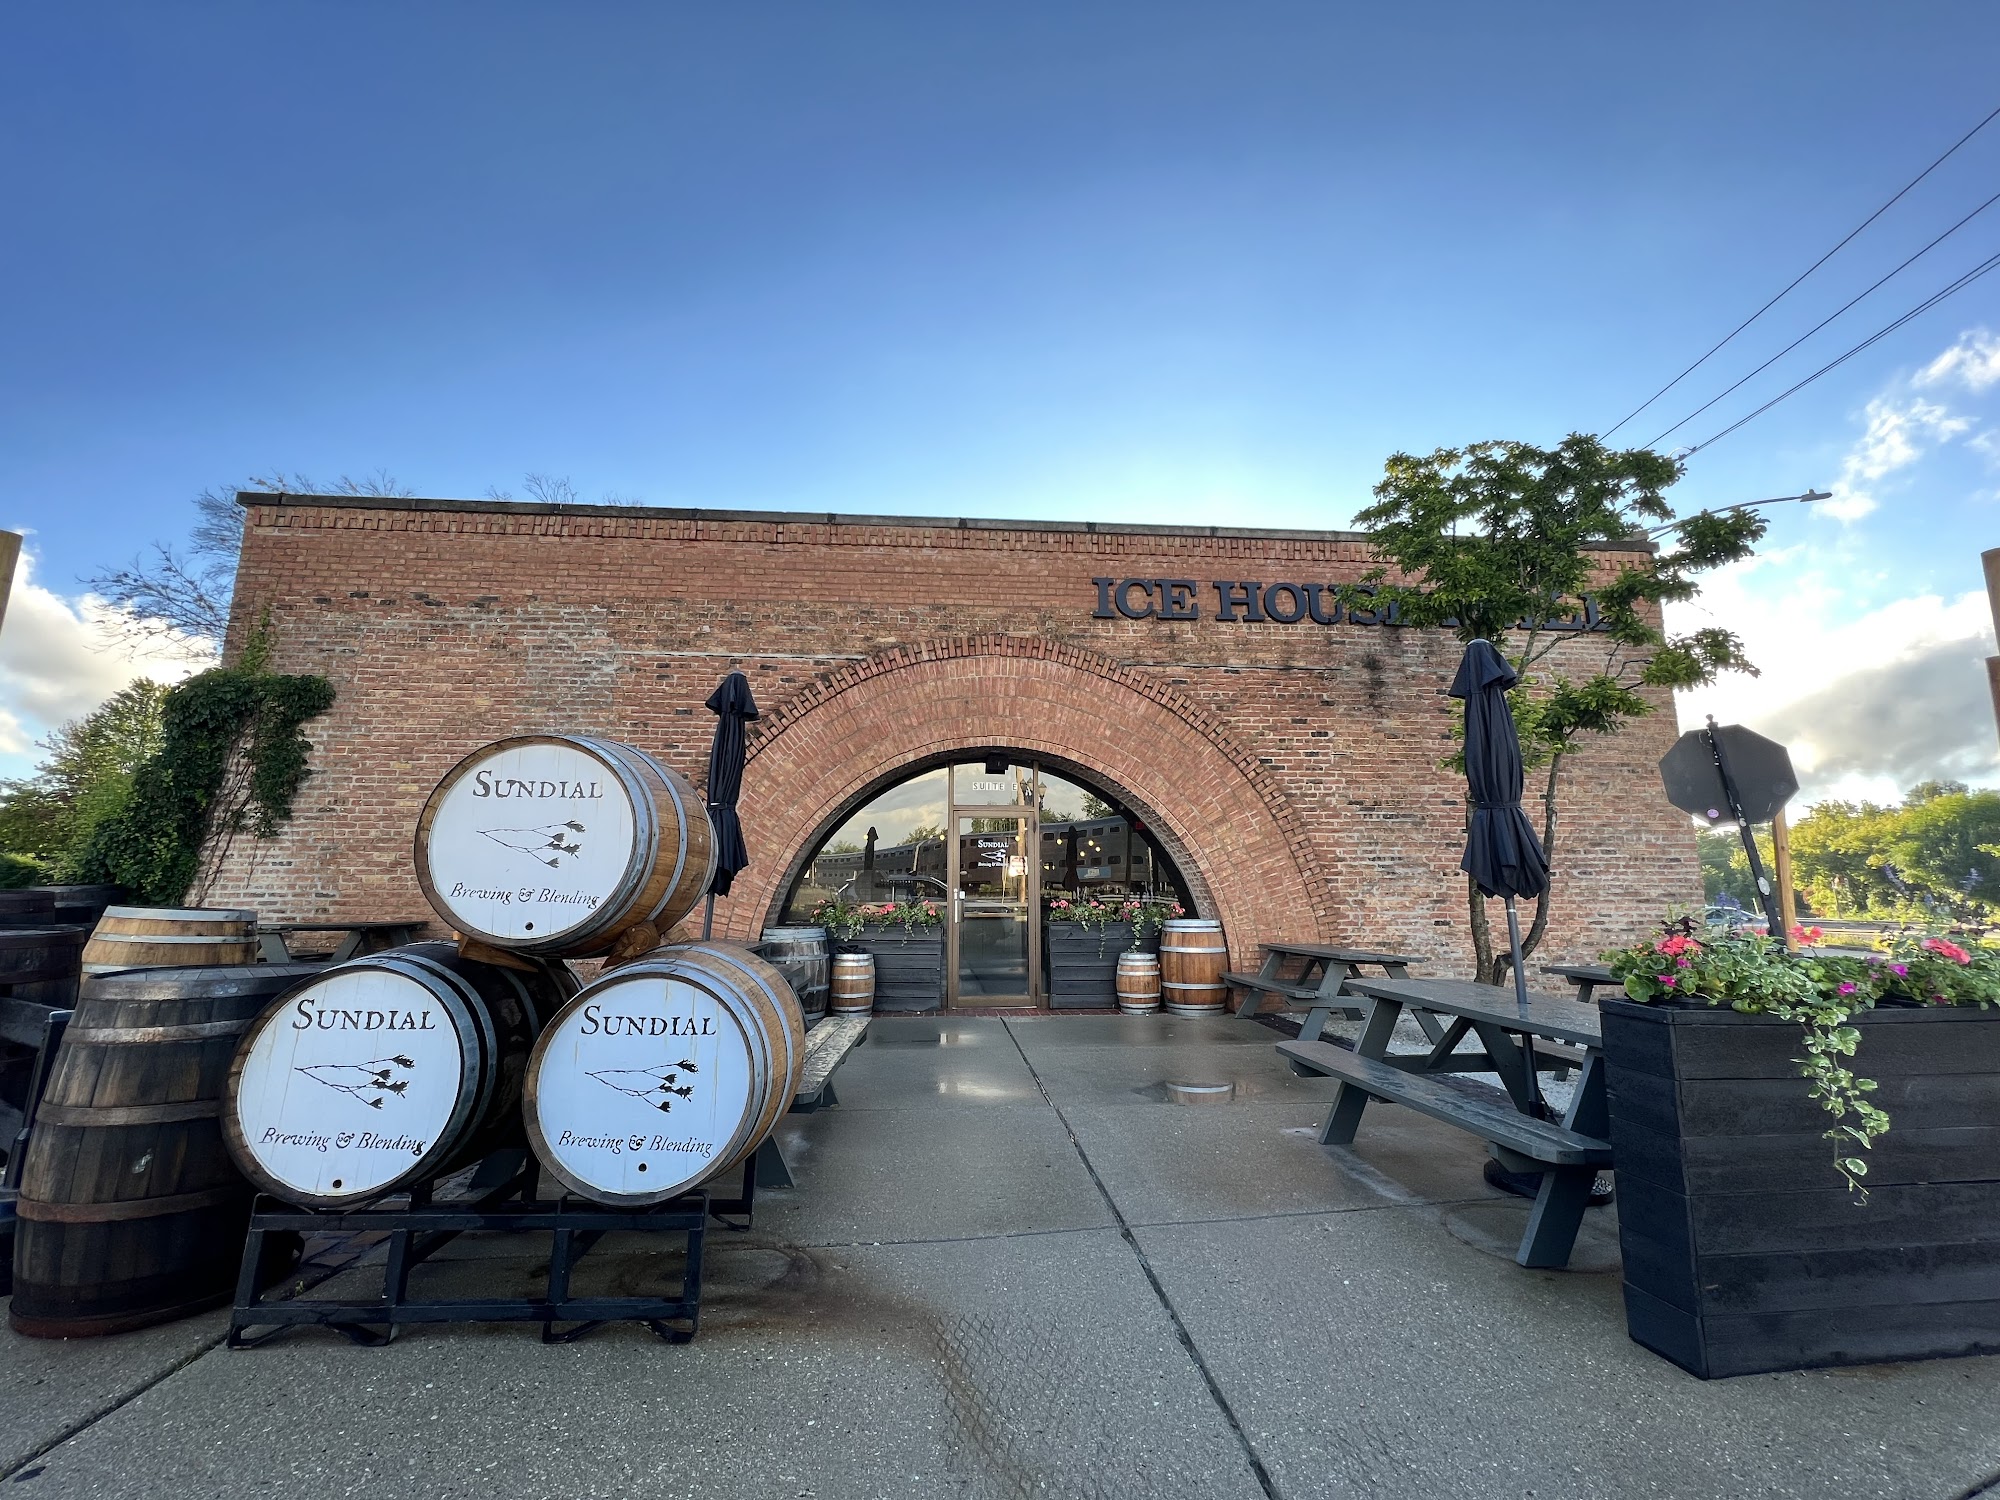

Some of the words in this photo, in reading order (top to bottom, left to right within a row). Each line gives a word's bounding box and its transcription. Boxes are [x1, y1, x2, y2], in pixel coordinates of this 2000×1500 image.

[1091, 577, 1199, 621] ICE
[472, 770, 604, 800] SUNDIAL
[973, 782, 1004, 790] SUITE
[1012, 783, 1017, 791] E
[449, 882, 514, 905] Brewing
[518, 887, 535, 902] &
[536, 887, 601, 909] Blending
[292, 998, 436, 1031] SUNDIAL
[580, 1005, 717, 1036] SUNDIAL
[259, 1127, 331, 1153] Brewing
[335, 1132, 355, 1149] &
[355, 1132, 427, 1157] Blending
[558, 1130, 624, 1154] Brewing
[629, 1134, 647, 1151] &
[648, 1134, 714, 1158] Blending
